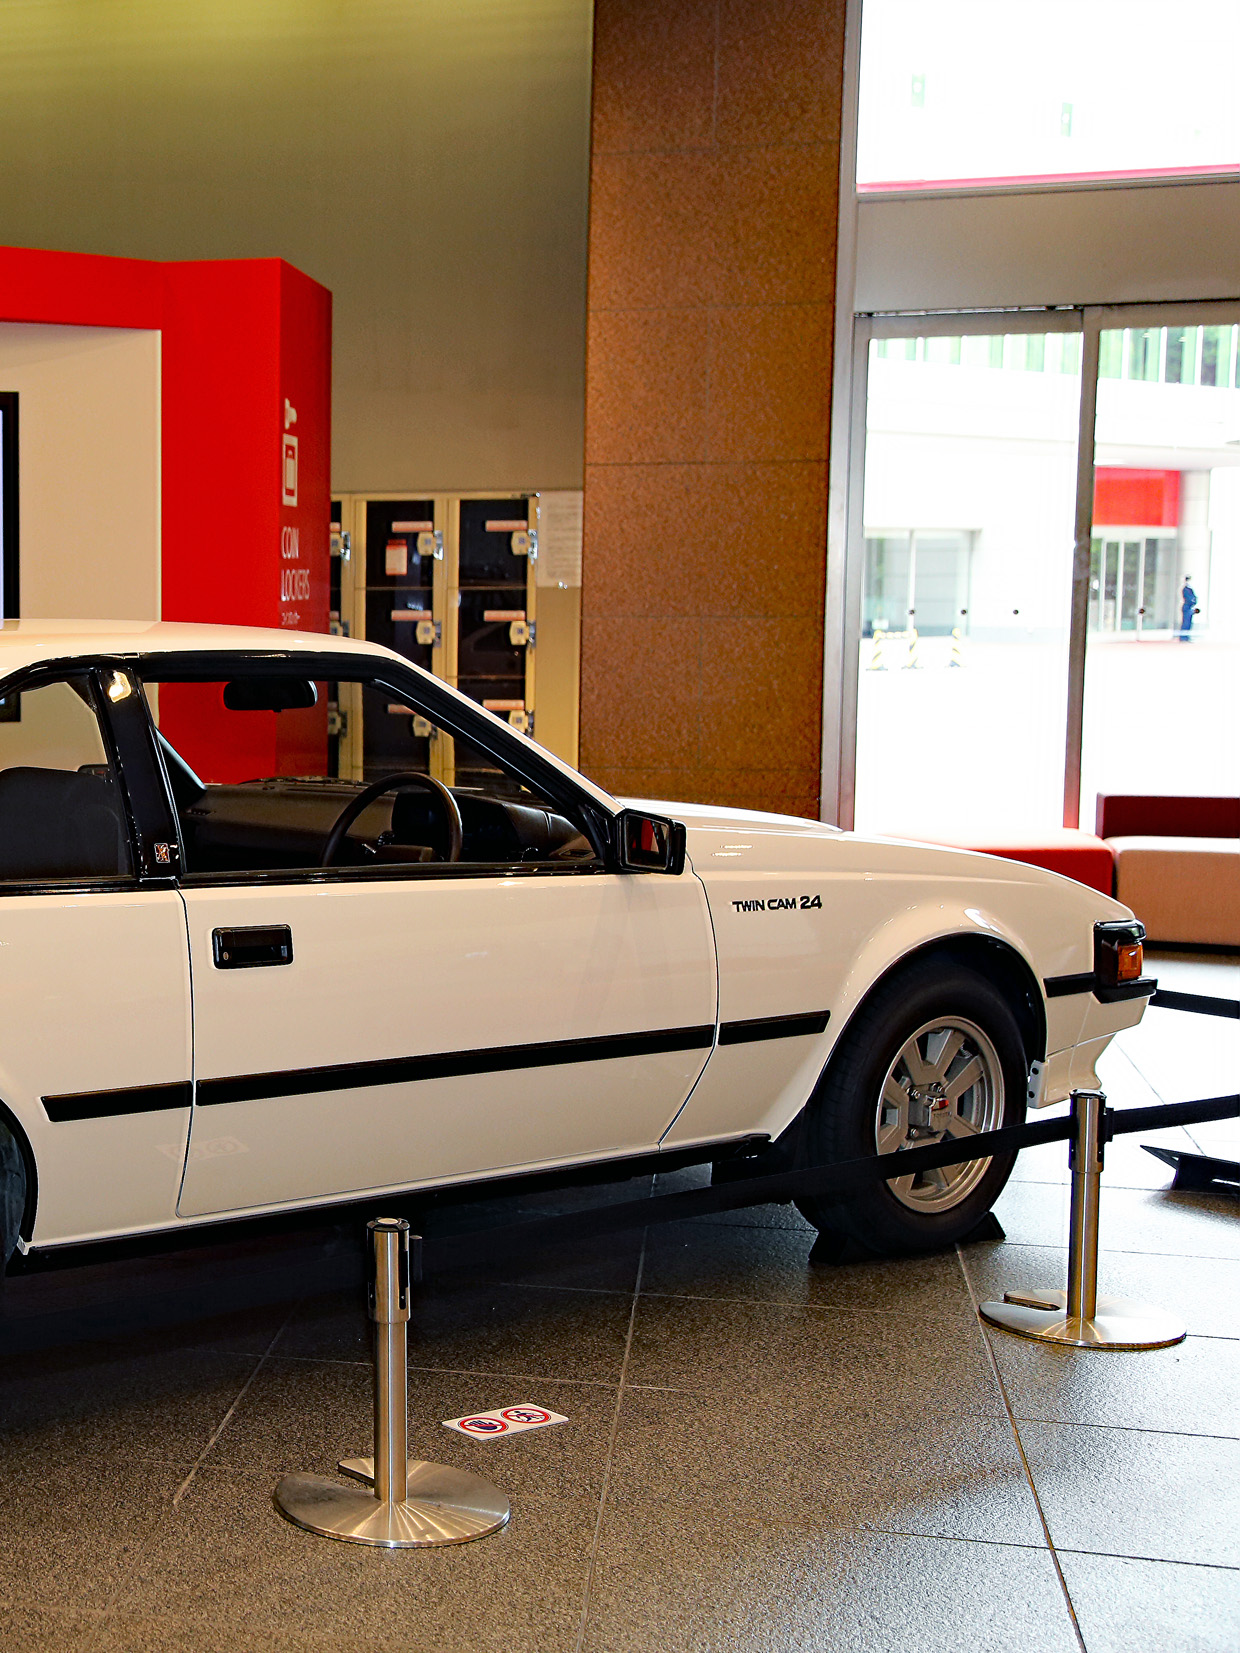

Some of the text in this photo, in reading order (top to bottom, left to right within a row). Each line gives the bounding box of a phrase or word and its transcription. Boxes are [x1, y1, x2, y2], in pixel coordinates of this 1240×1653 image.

[732, 895, 822, 912] TWIN CAM 24
